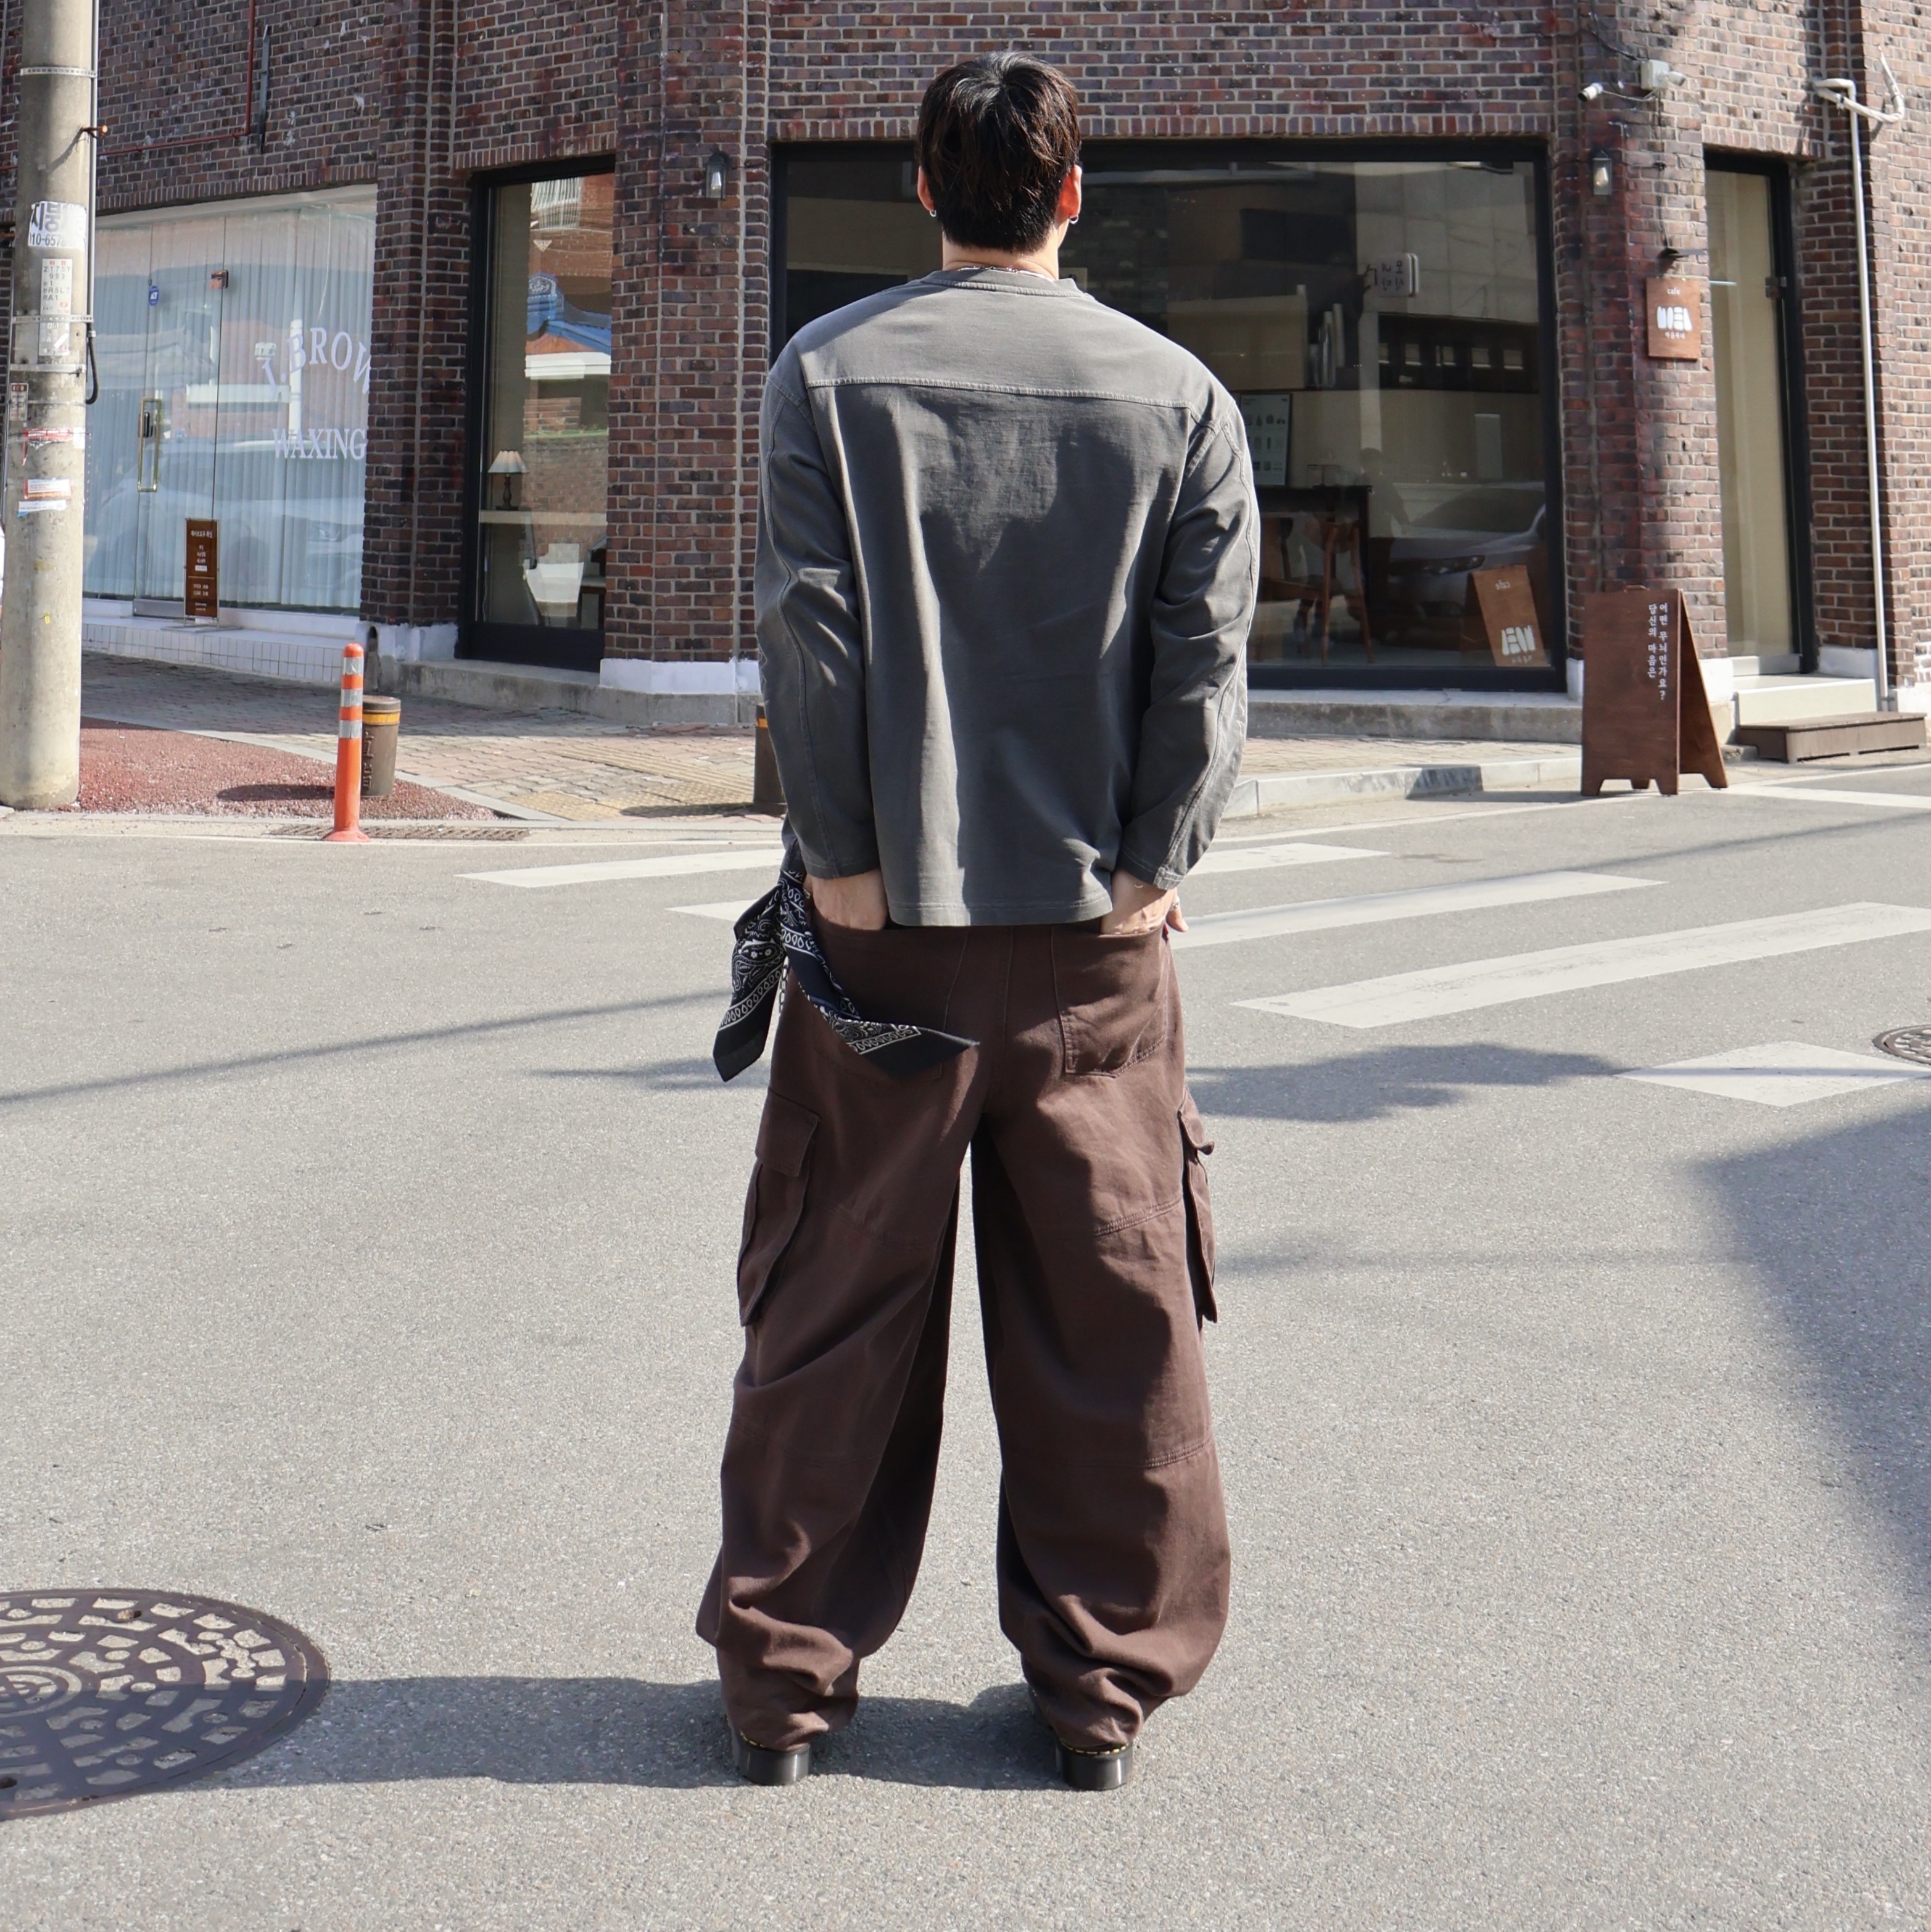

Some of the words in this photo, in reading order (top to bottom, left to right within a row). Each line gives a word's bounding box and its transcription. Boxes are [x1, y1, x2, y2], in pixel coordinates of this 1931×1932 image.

[272, 428, 368, 460] WAXING
[1648, 603, 1657, 637] 당신의
[1647, 643, 1656, 679] 마음은
[1658, 632, 1667, 700] 무늬인가요?
